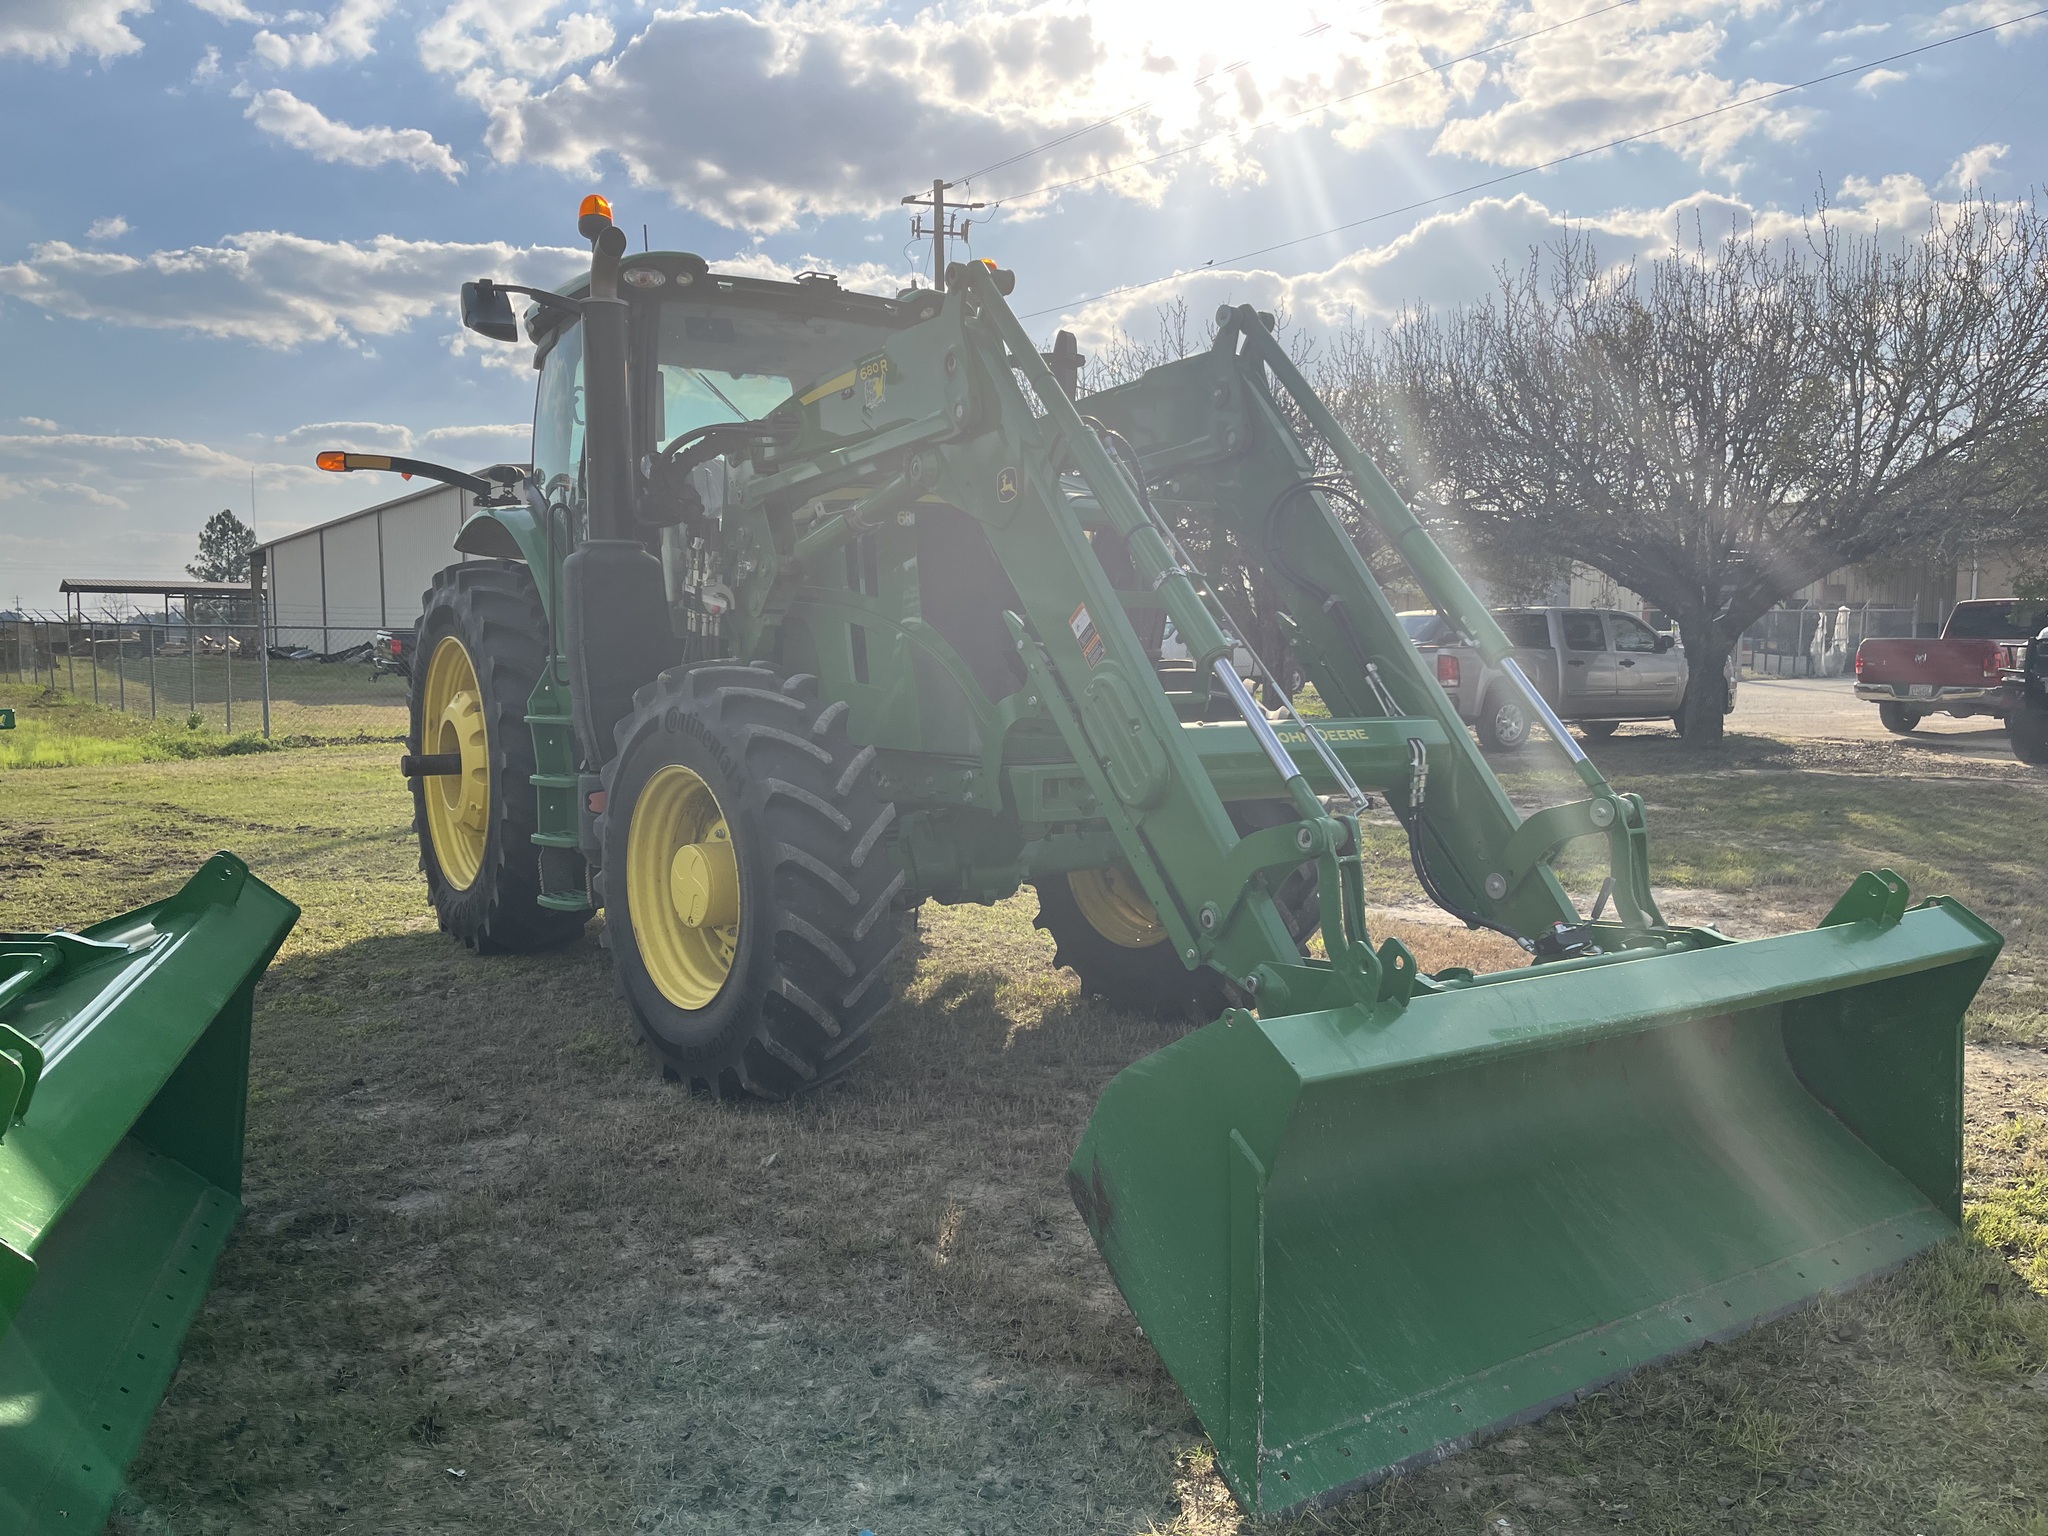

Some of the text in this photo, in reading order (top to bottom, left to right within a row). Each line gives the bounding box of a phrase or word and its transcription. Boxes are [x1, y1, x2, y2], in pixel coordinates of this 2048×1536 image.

[665, 705, 738, 780] Continental
[1277, 728, 1370, 744] OH DEERE
